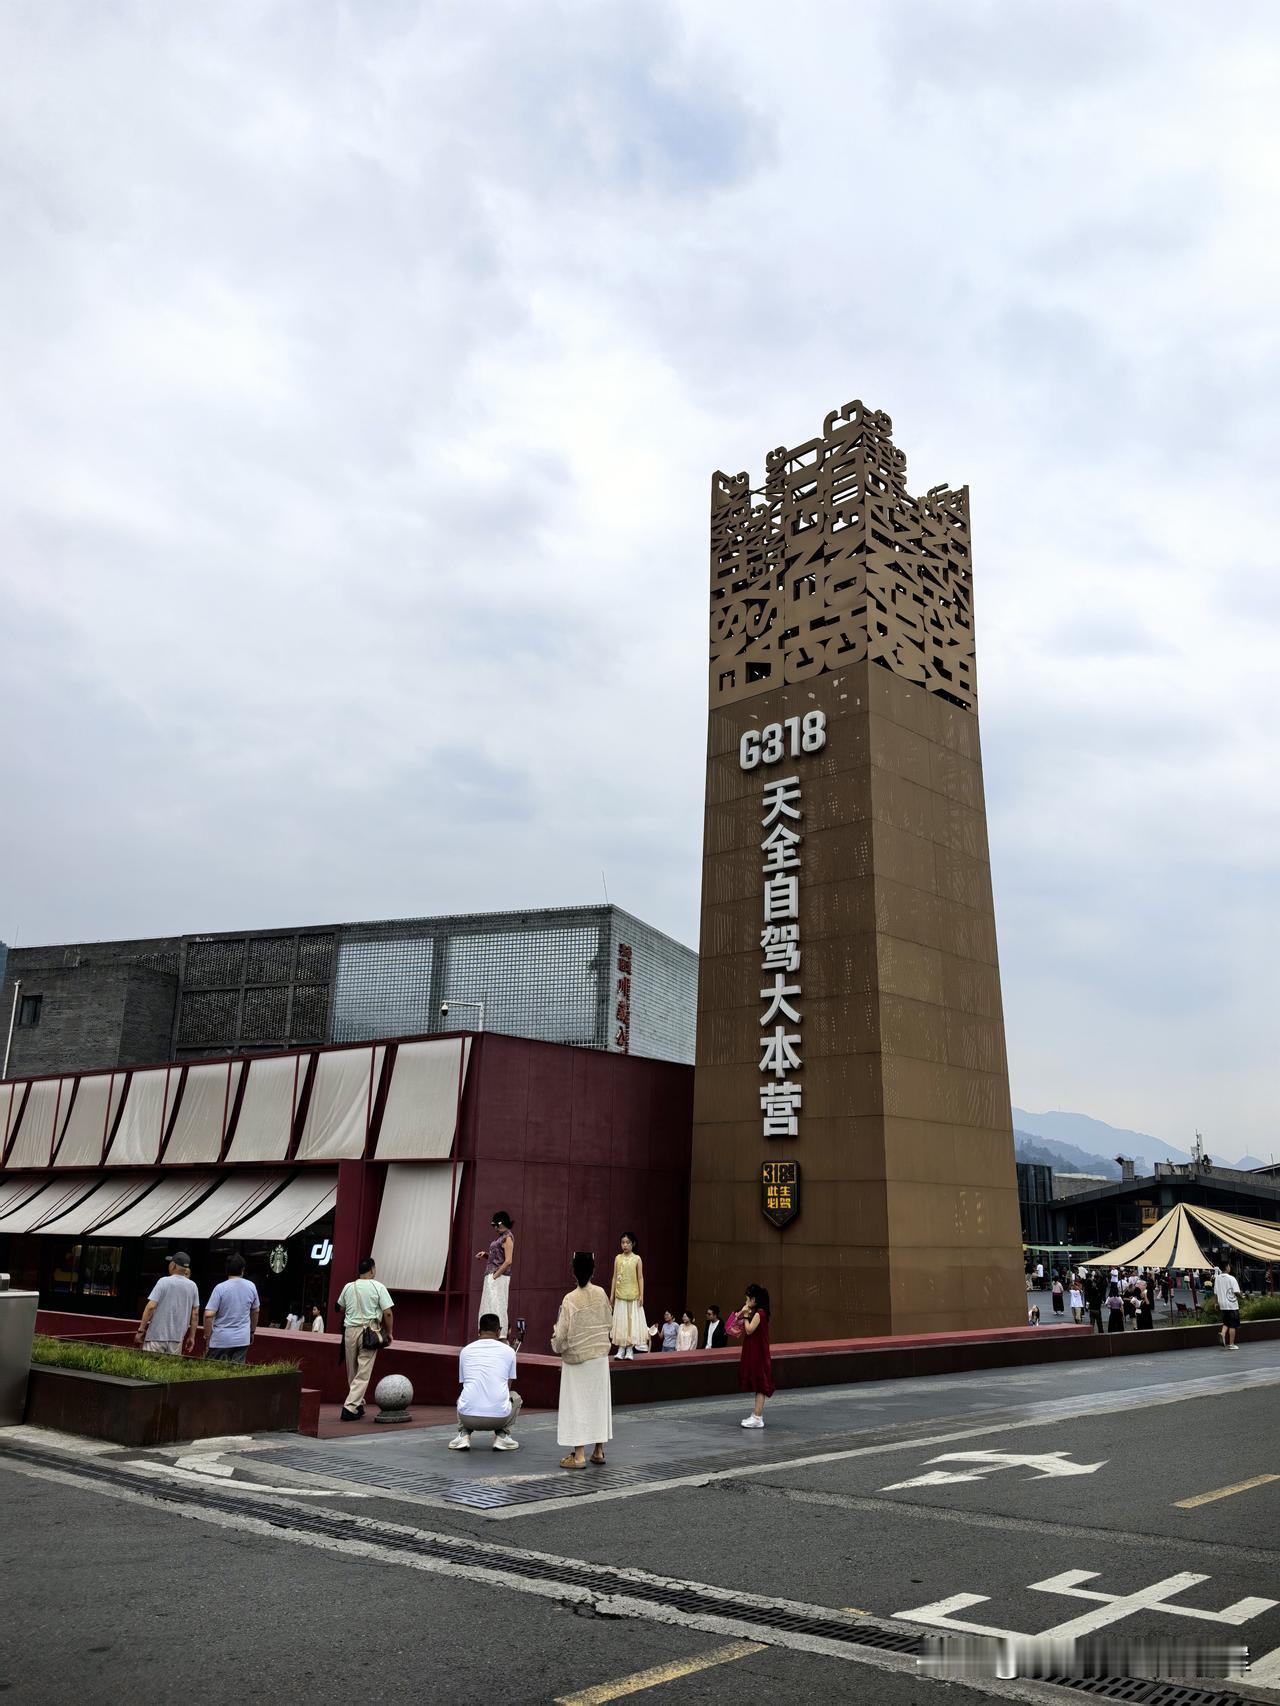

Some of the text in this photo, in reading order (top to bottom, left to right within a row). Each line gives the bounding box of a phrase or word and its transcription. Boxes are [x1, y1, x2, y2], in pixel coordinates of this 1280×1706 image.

[785, 437, 825, 684] CHENGDU
[824, 399, 866, 671] CHONGQING
[892, 510, 926, 687] WUHAN
[710, 548, 746, 706] ENSHI
[746, 563, 784, 697] LASA
[739, 710, 826, 771] G318
[759, 775, 802, 1136] 天全自驾大本营
[764, 1164, 788, 1183] 318
[767, 1185, 791, 1197] 此生
[767, 1197, 791, 1209] 必驾
[310, 1239, 334, 1266] dj
